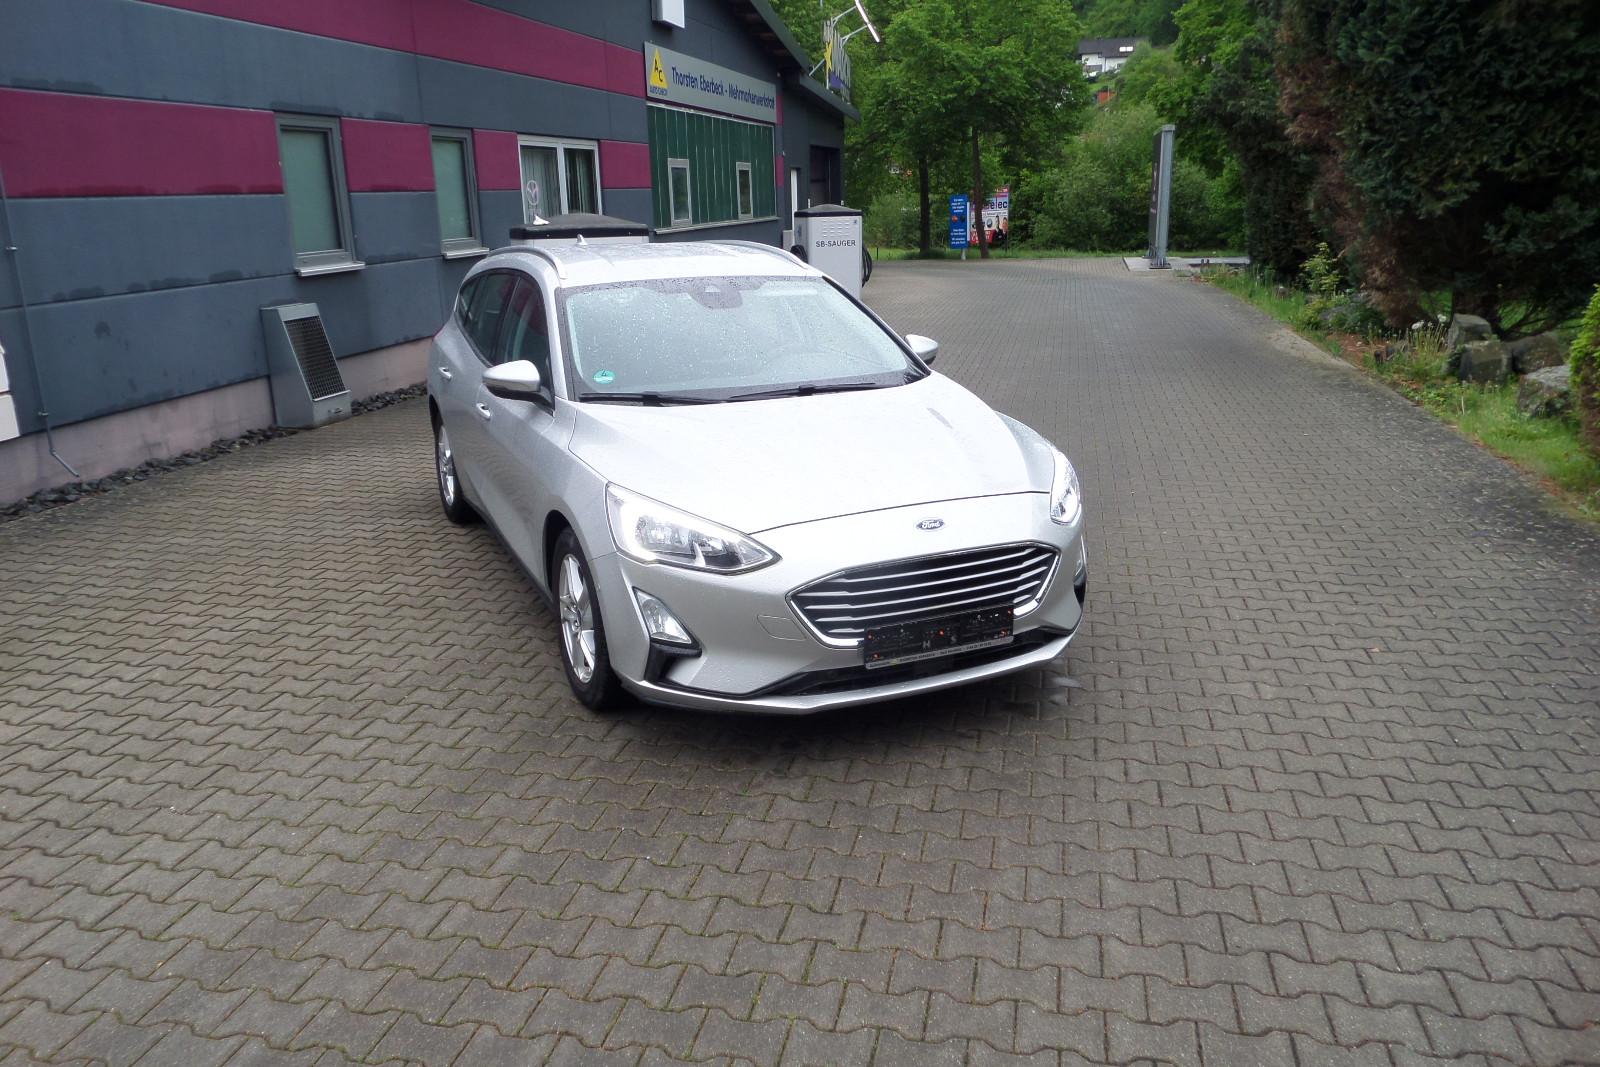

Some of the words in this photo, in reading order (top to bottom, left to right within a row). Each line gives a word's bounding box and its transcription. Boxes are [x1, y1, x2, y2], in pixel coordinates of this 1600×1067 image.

[671, 66, 699, 89] Thorsten
[699, 75, 724, 96] Eberbeck
[815, 240, 856, 248] SB-SAUGER
[920, 520, 942, 529] Ford
